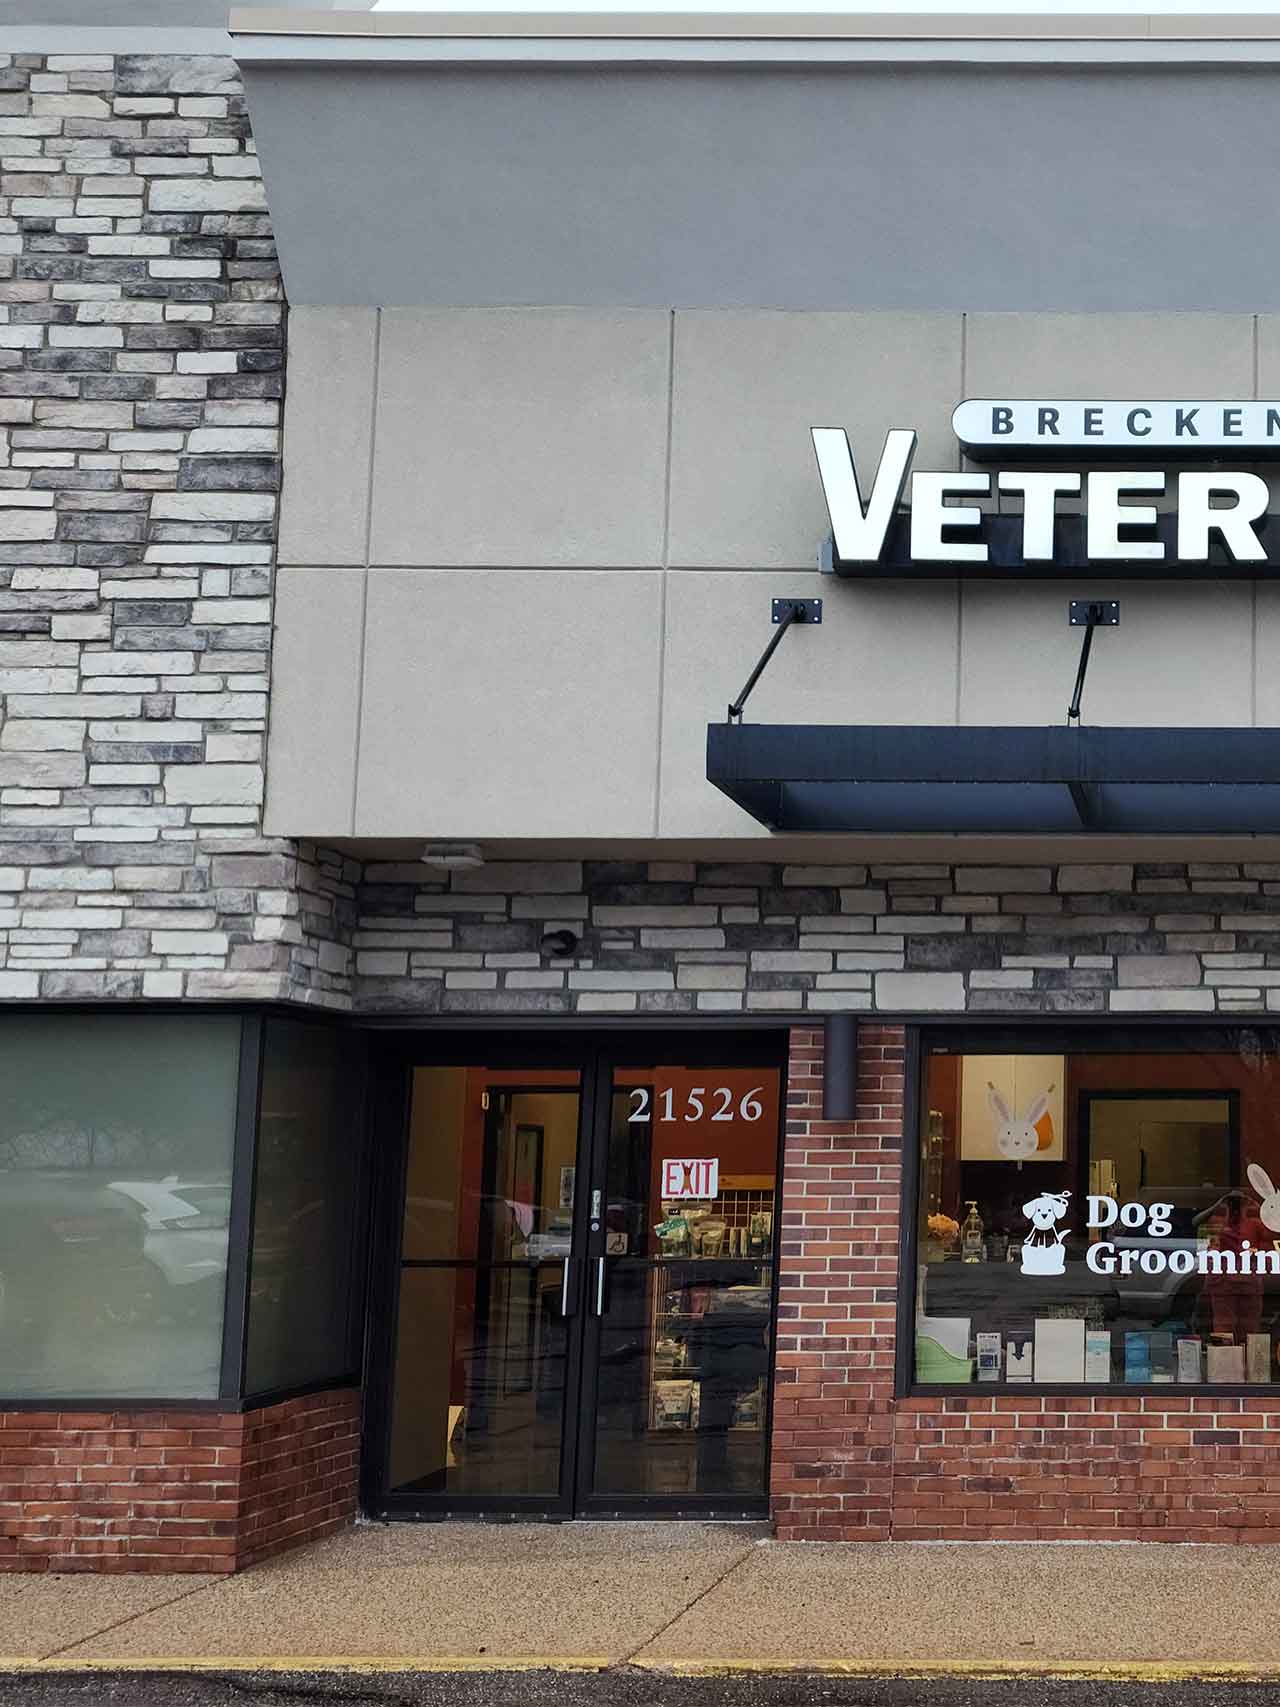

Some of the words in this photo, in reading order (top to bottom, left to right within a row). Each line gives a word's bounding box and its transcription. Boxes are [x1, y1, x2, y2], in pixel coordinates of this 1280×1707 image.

[627, 1087, 763, 1122] 21526
[665, 1161, 714, 1196] EXIT
[1086, 1195, 1175, 1237] Dog
